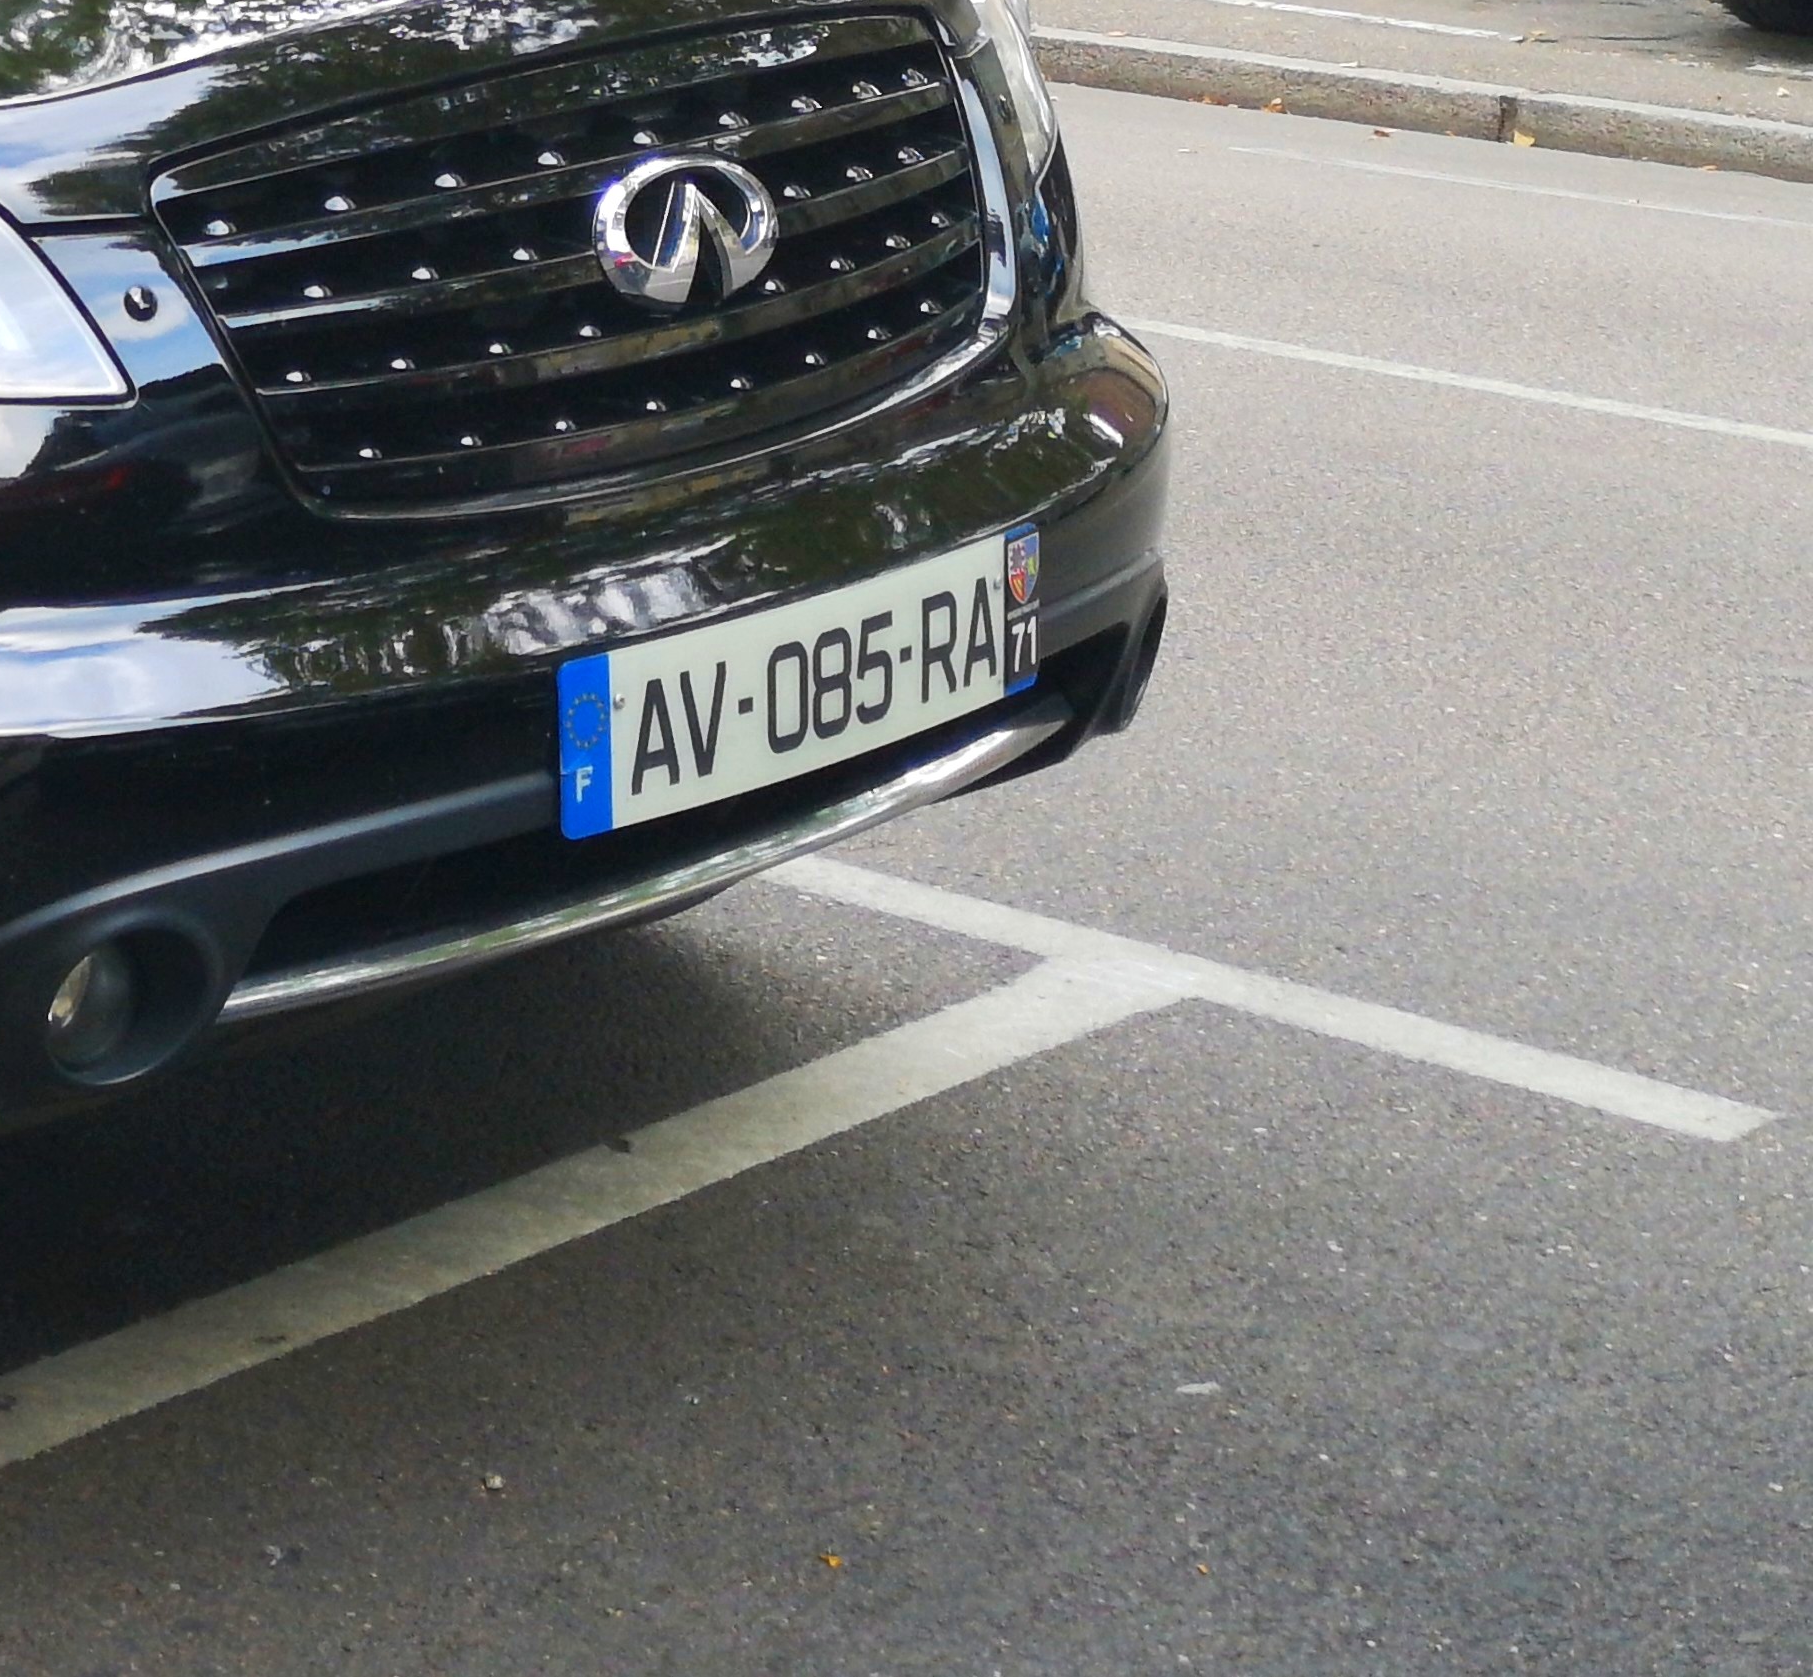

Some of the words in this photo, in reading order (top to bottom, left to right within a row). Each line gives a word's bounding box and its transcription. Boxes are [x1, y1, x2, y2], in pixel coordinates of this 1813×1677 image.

[1011, 615, 1038, 673] 71
[631, 576, 997, 795] AV-085-RA
[575, 765, 594, 803] F
